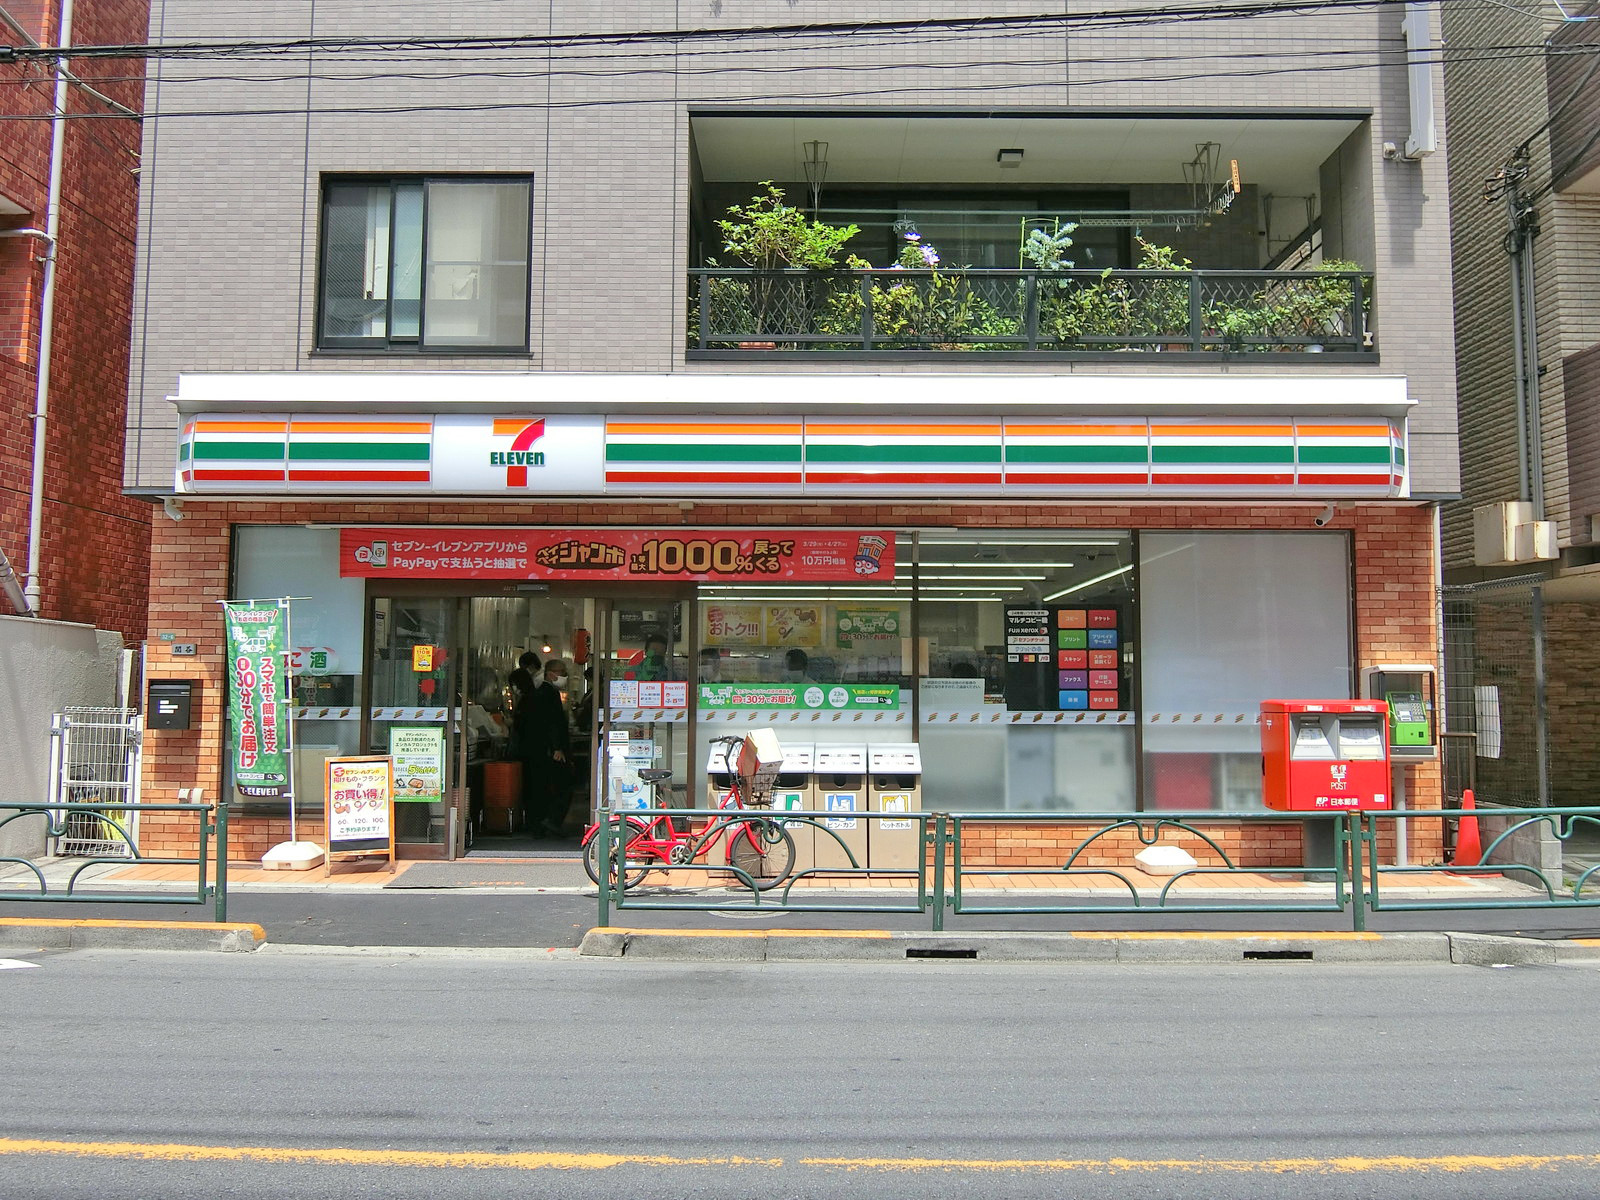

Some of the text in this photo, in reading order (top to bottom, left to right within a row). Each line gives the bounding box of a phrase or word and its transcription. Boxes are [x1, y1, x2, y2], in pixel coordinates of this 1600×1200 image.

[493, 418, 545, 486] 7
[753, 540, 793, 555] 戻って
[393, 556, 527, 570] PayPayで支払うと抽選で
[755, 556, 780, 570] くる
[802, 555, 846, 566] 10万円相当
[310, 651, 328, 668] 酒
[1330, 782, 1347, 790] POST
